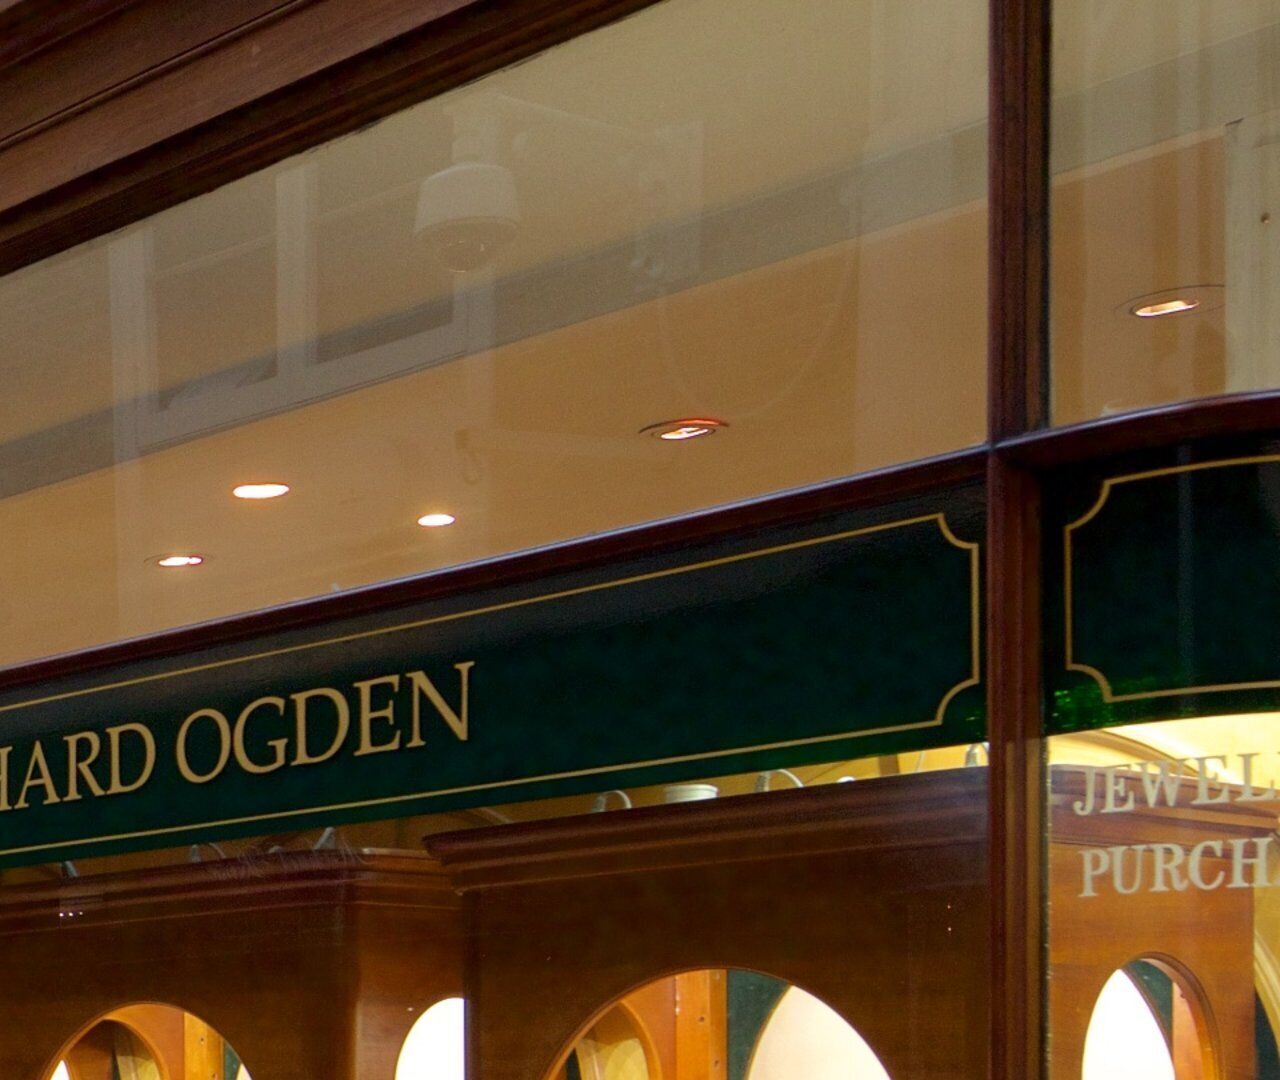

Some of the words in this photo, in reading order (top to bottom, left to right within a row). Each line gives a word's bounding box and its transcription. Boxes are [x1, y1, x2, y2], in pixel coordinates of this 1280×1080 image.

[175, 661, 476, 785] OGDEN
[1073, 752, 1280, 816] JEWEL
[1078, 836, 1280, 898] PURCH
